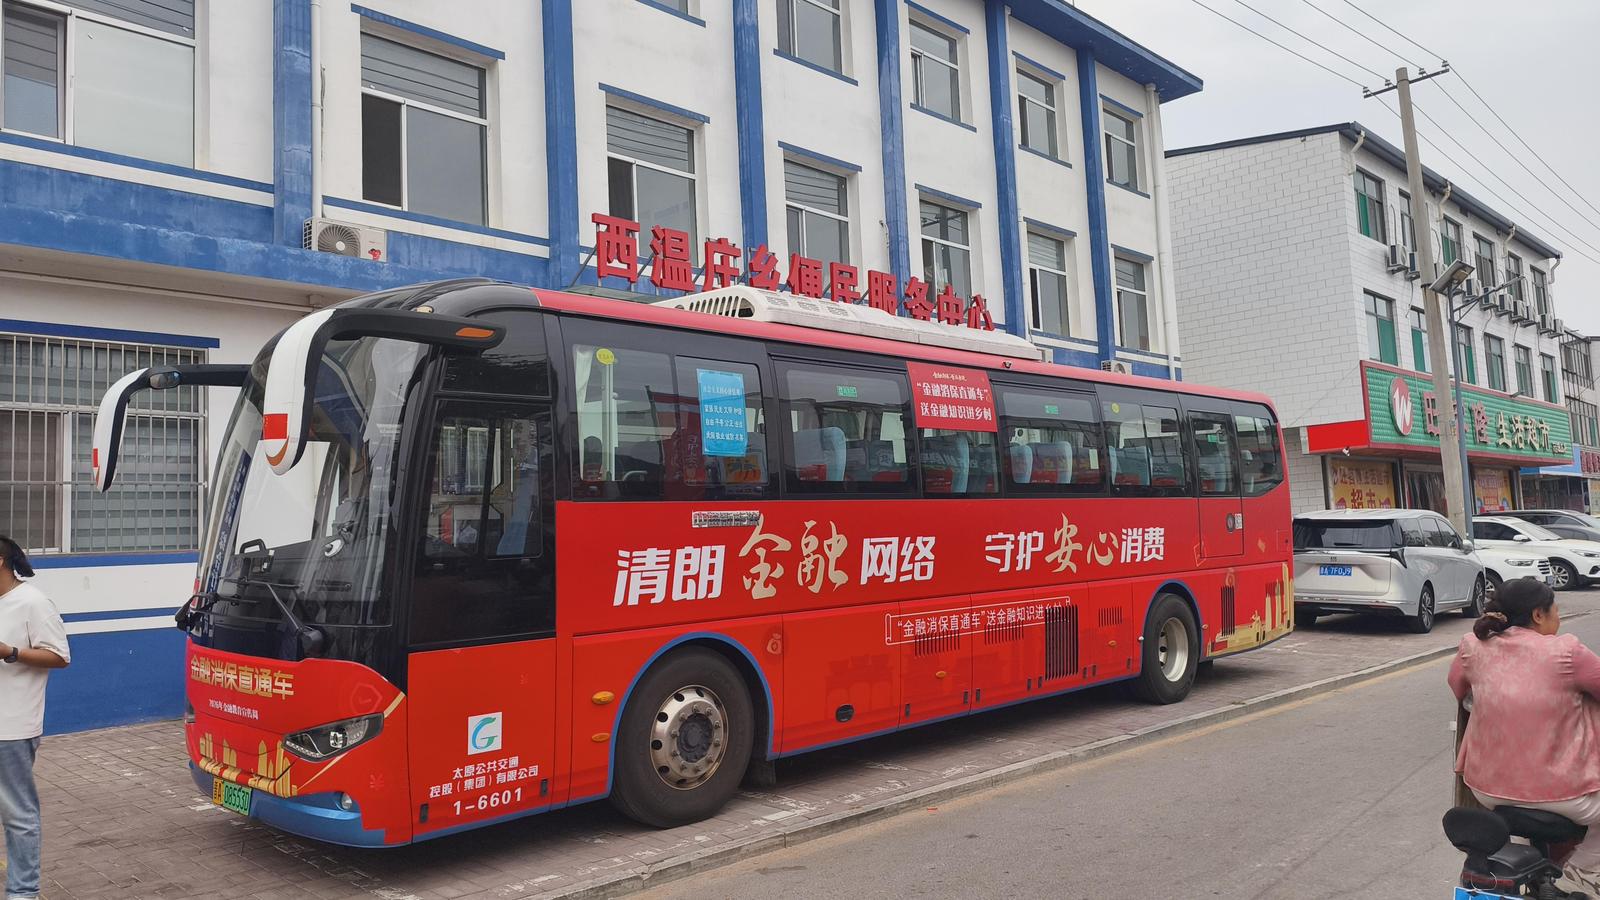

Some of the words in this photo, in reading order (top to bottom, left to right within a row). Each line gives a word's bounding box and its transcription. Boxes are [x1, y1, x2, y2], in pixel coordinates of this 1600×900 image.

[591, 212, 995, 332] 西温庄乡便民服务中心
[920, 402, 992, 421] 送金融知识进乡村
[1496, 411, 1550, 452] 生活超市
[613, 513, 936, 606] 清朗金融网络
[985, 511, 1165, 574] 守护安心消费
[190, 655, 295, 700] 金融消保直通车
[452, 756, 519, 780] 太原公共交通
